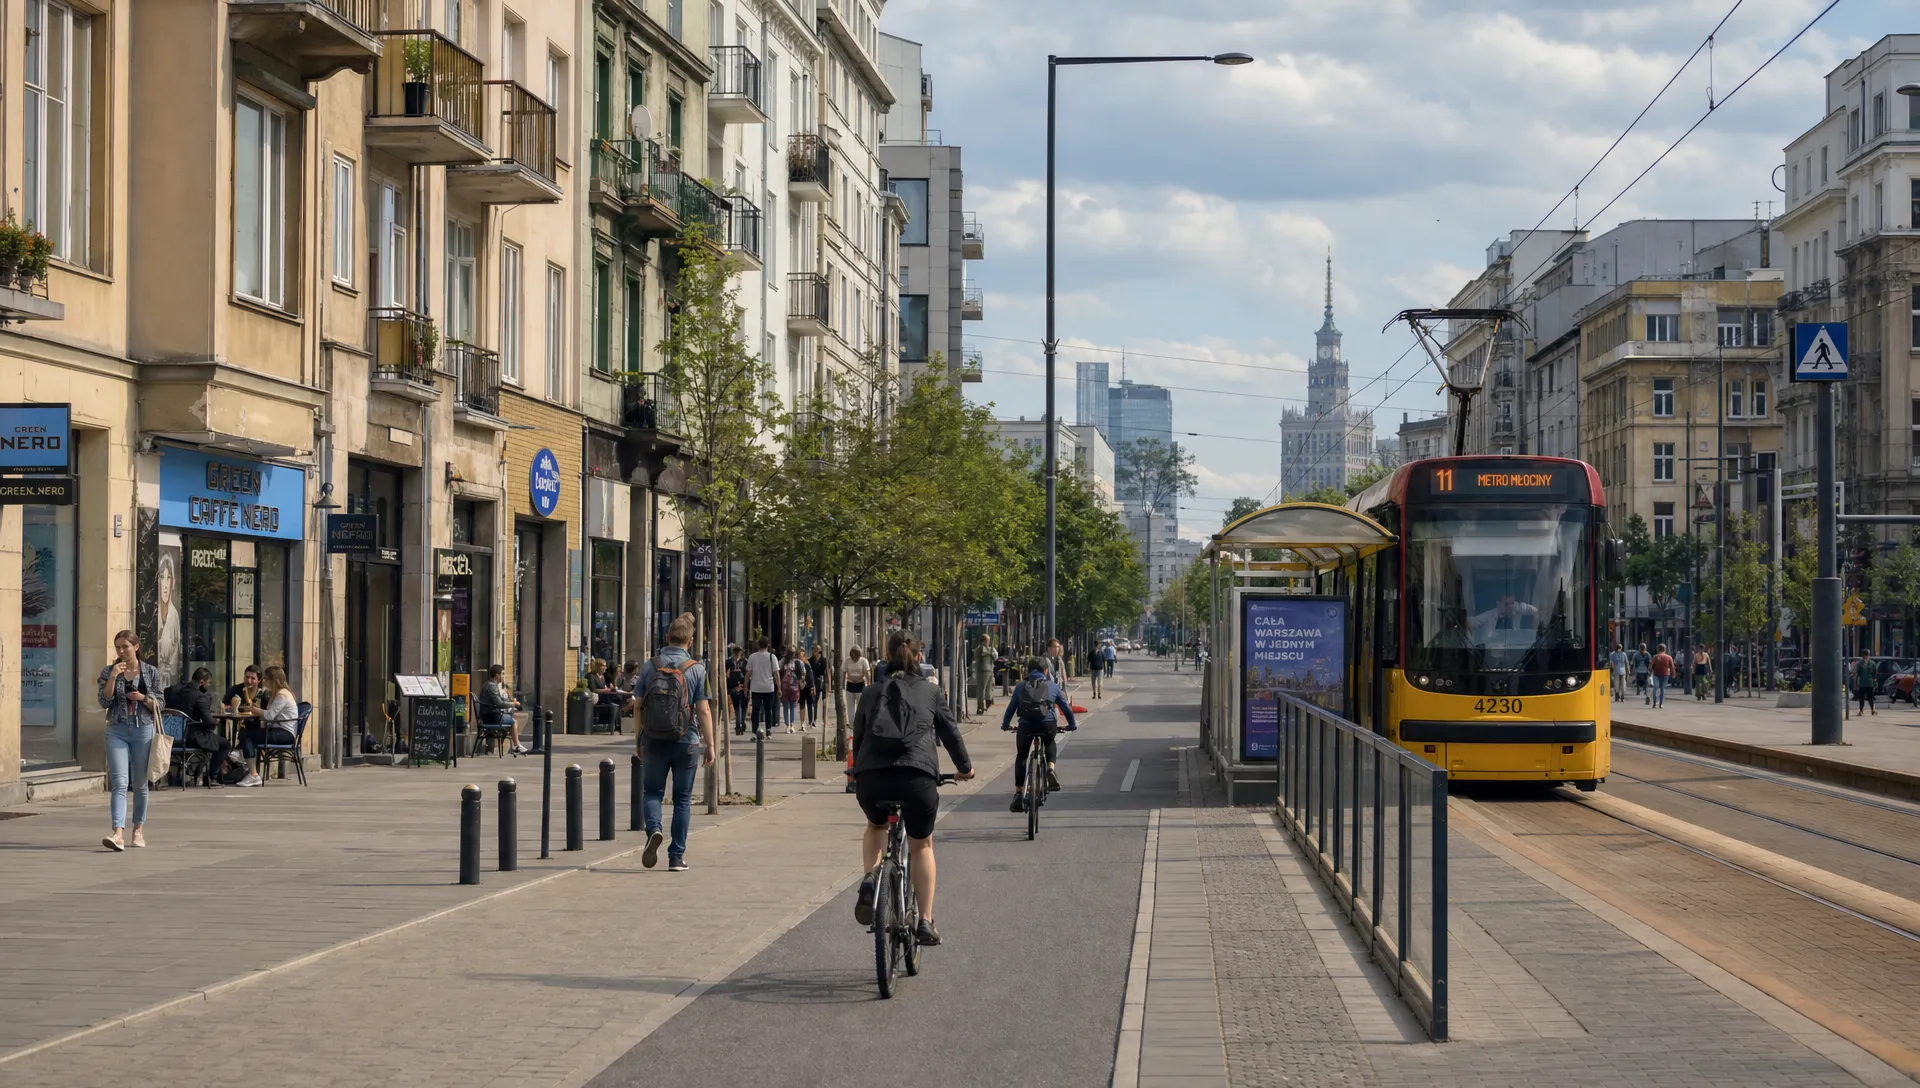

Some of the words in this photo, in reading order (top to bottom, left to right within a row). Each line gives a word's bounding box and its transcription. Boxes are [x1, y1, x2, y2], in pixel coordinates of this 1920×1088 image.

[0, 436, 61, 450] NERO
[206, 462, 263, 496] GREEN
[1436, 469, 1453, 491] 11
[1477, 474, 1509, 487] METRO
[1510, 474, 1553, 487] MŁOCINY
[37, 486, 65, 496] NERO
[1254, 617, 1285, 626] CAŁA
[1254, 628, 1322, 638] WARSZAWA
[1254, 640, 1266, 649] W
[1269, 640, 1315, 649] JEDNYM
[1254, 652, 1304, 660] MIEJSCU
[1474, 698, 1522, 714] 4230
